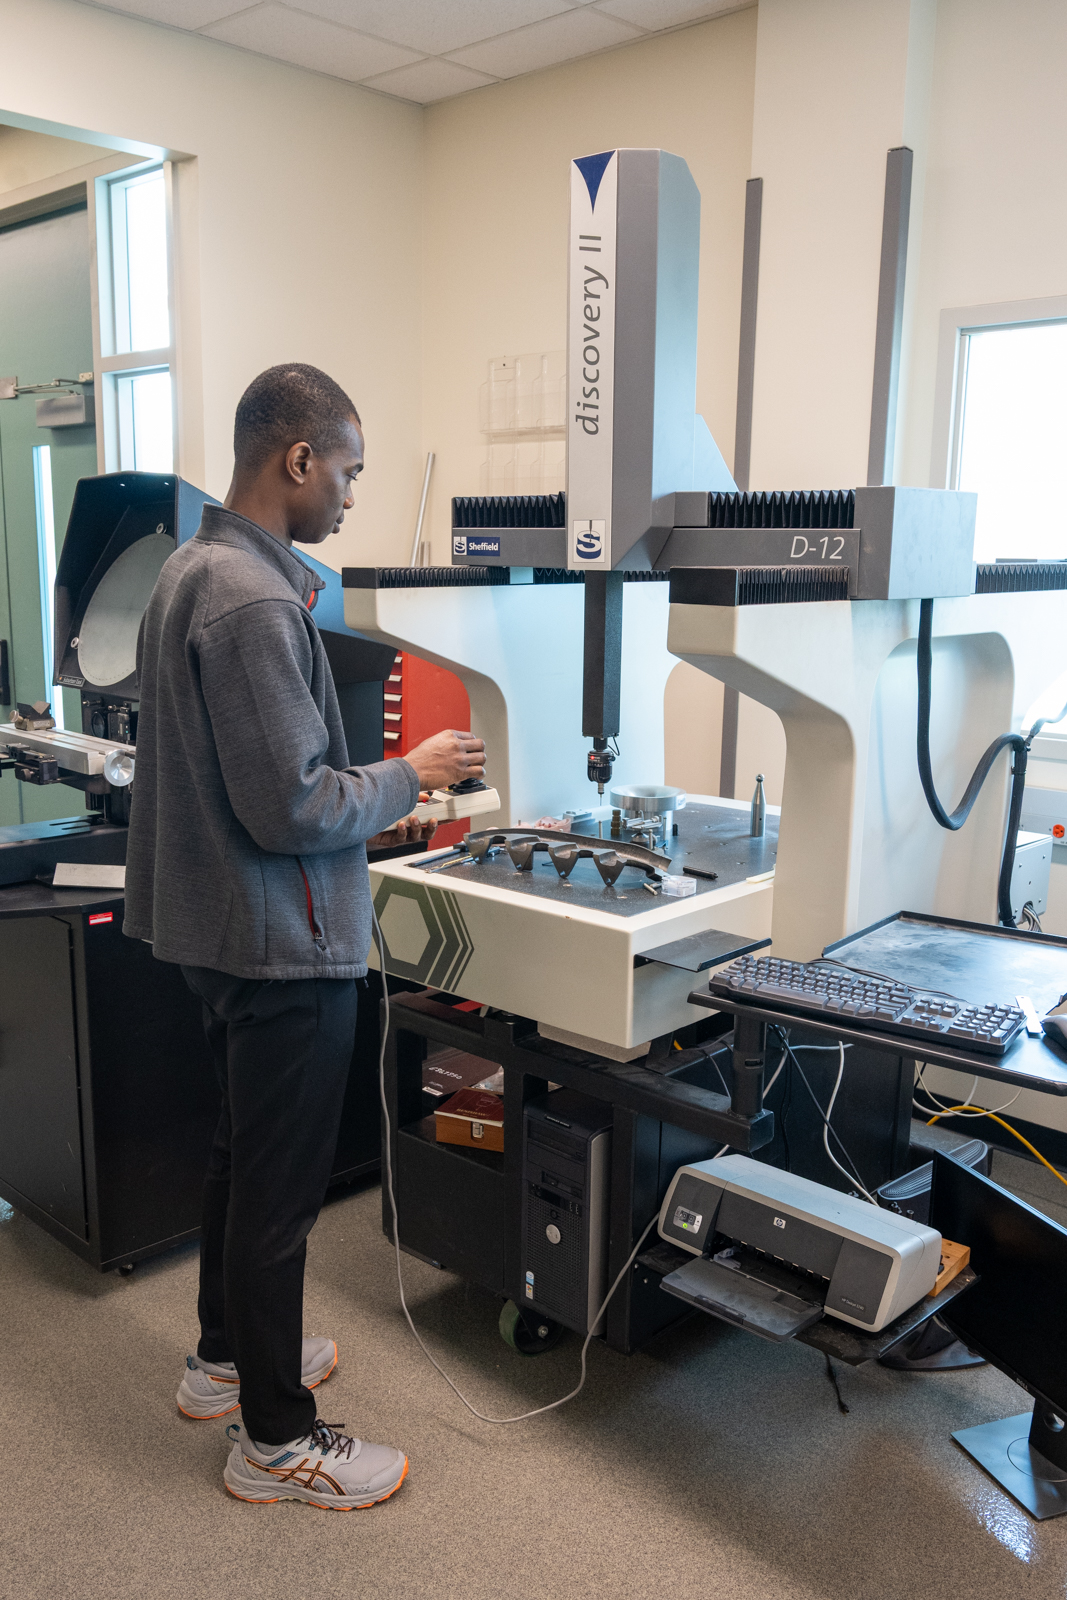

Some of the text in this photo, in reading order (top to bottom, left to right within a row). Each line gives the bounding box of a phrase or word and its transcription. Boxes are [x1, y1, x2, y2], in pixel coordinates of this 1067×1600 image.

[575, 265, 609, 435] discovery
[469, 542, 498, 551] Sheffield
[790, 535, 845, 560] D-12
